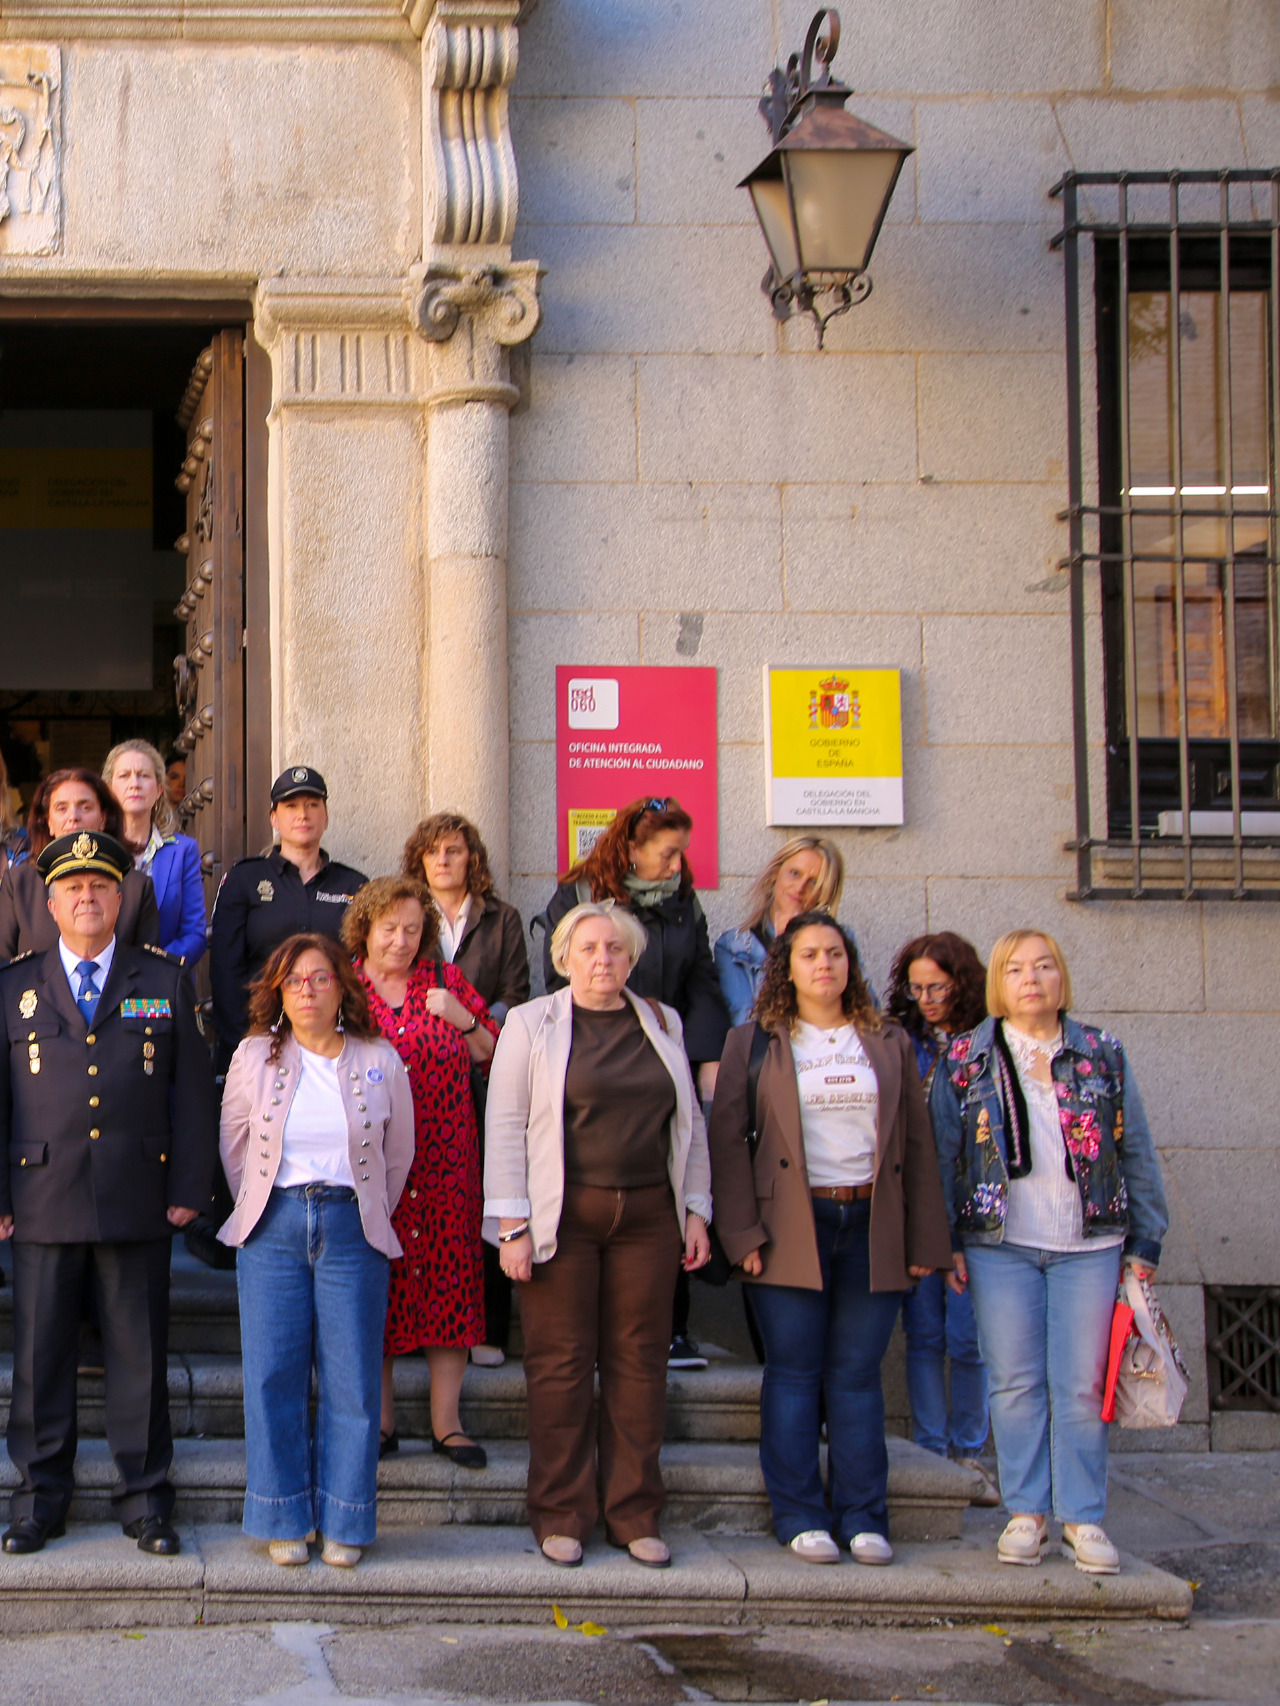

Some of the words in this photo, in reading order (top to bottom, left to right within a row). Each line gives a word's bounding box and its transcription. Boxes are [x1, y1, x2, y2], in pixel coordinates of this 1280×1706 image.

[48, 488, 96, 497] GOBIERNO
[571, 685, 594, 699] red
[571, 698, 596, 712] 060
[809, 738, 861, 747] GOBIERNO
[568, 742, 607, 753] OFICINA
[608, 742, 662, 754] INTEGRADA
[828, 748, 841, 757] DE
[568, 757, 582, 768] DE
[583, 756, 631, 769] ATENCIÓN
[632, 758, 645, 769] AL
[646, 758, 704, 770] CIUDADANO
[816, 758, 854, 768] ESPAÑA
[803, 789, 854, 798] DELEGACIÓN
[856, 790, 871, 798] DEL
[810, 799, 852, 807] GOBIERNO
[854, 799, 866, 807] EN
[796, 807, 845, 816] CASTILLA-LA
[846, 807, 880, 816] MANCHA
